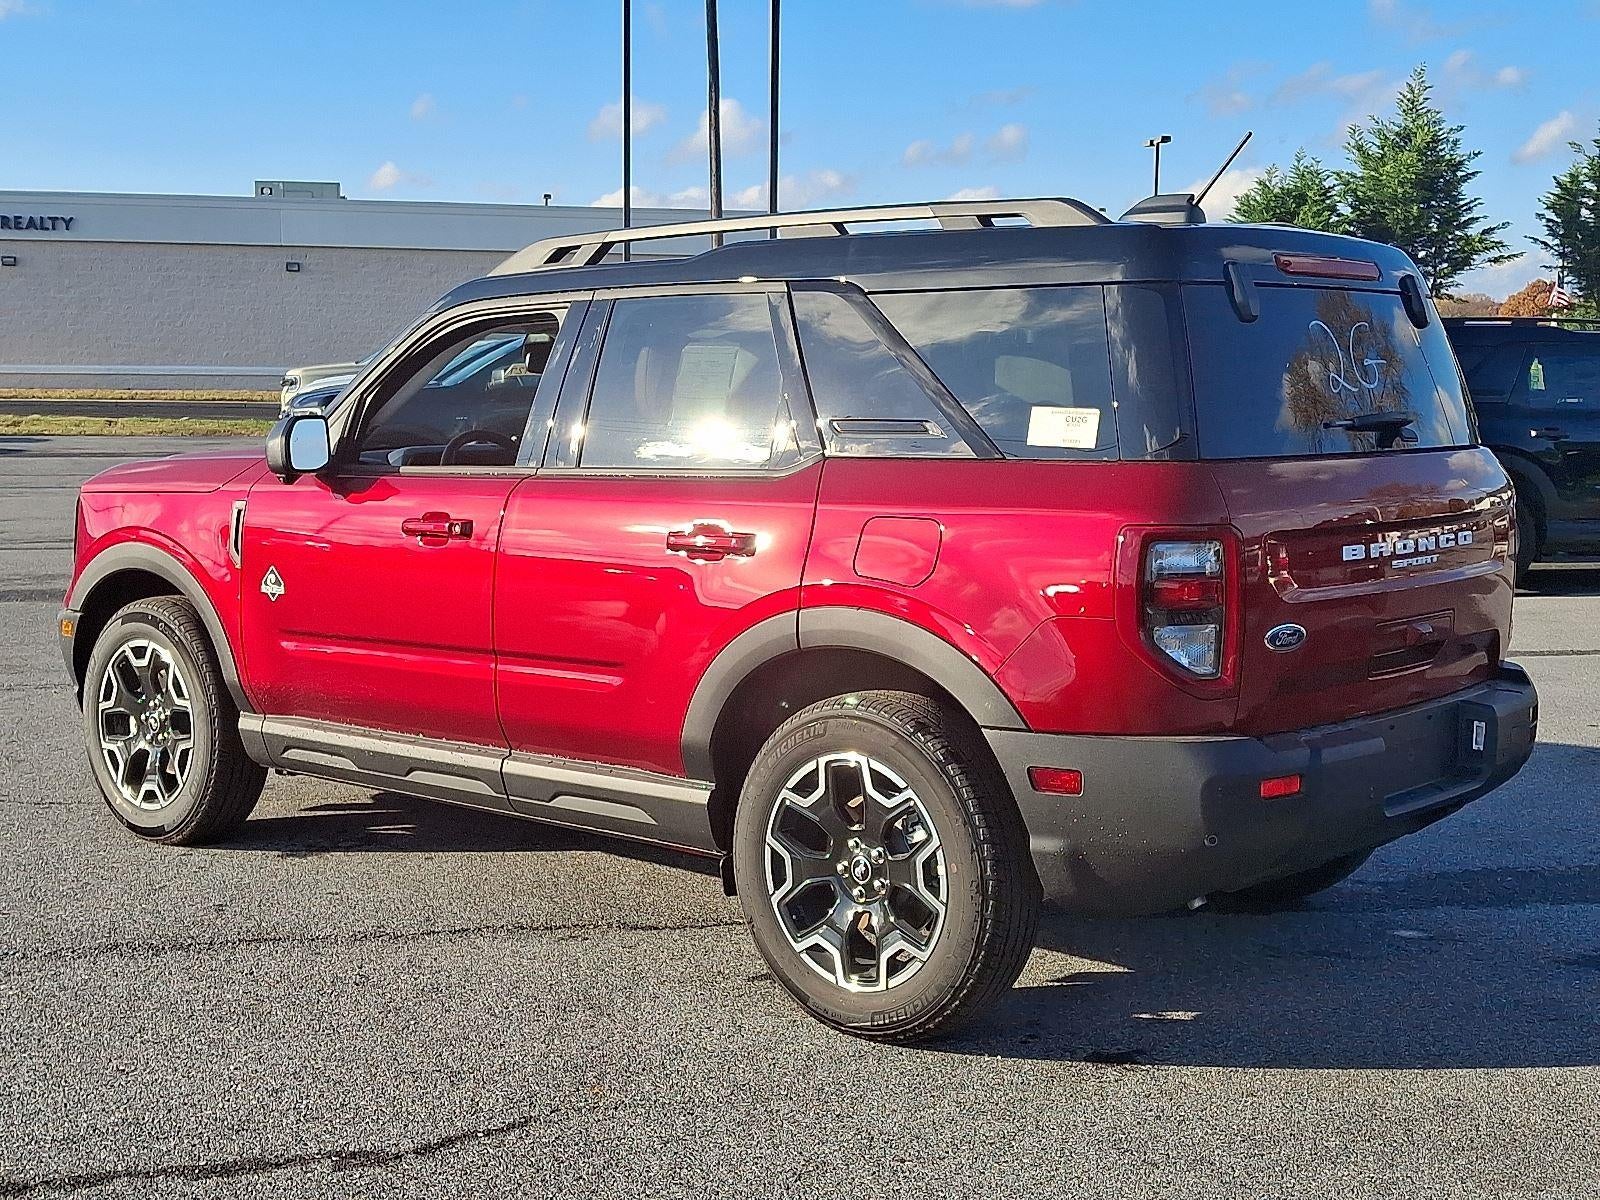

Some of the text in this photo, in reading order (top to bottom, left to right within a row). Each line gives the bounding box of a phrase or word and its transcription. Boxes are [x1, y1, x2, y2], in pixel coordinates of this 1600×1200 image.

[0, 215, 74, 231] REALTY
[1308, 320, 1387, 393] 2G
[1342, 530, 1473, 562] BRONCO
[1391, 554, 1440, 569] SPORT
[1275, 630, 1299, 646] Ford
[767, 722, 826, 768] MICHELIN
